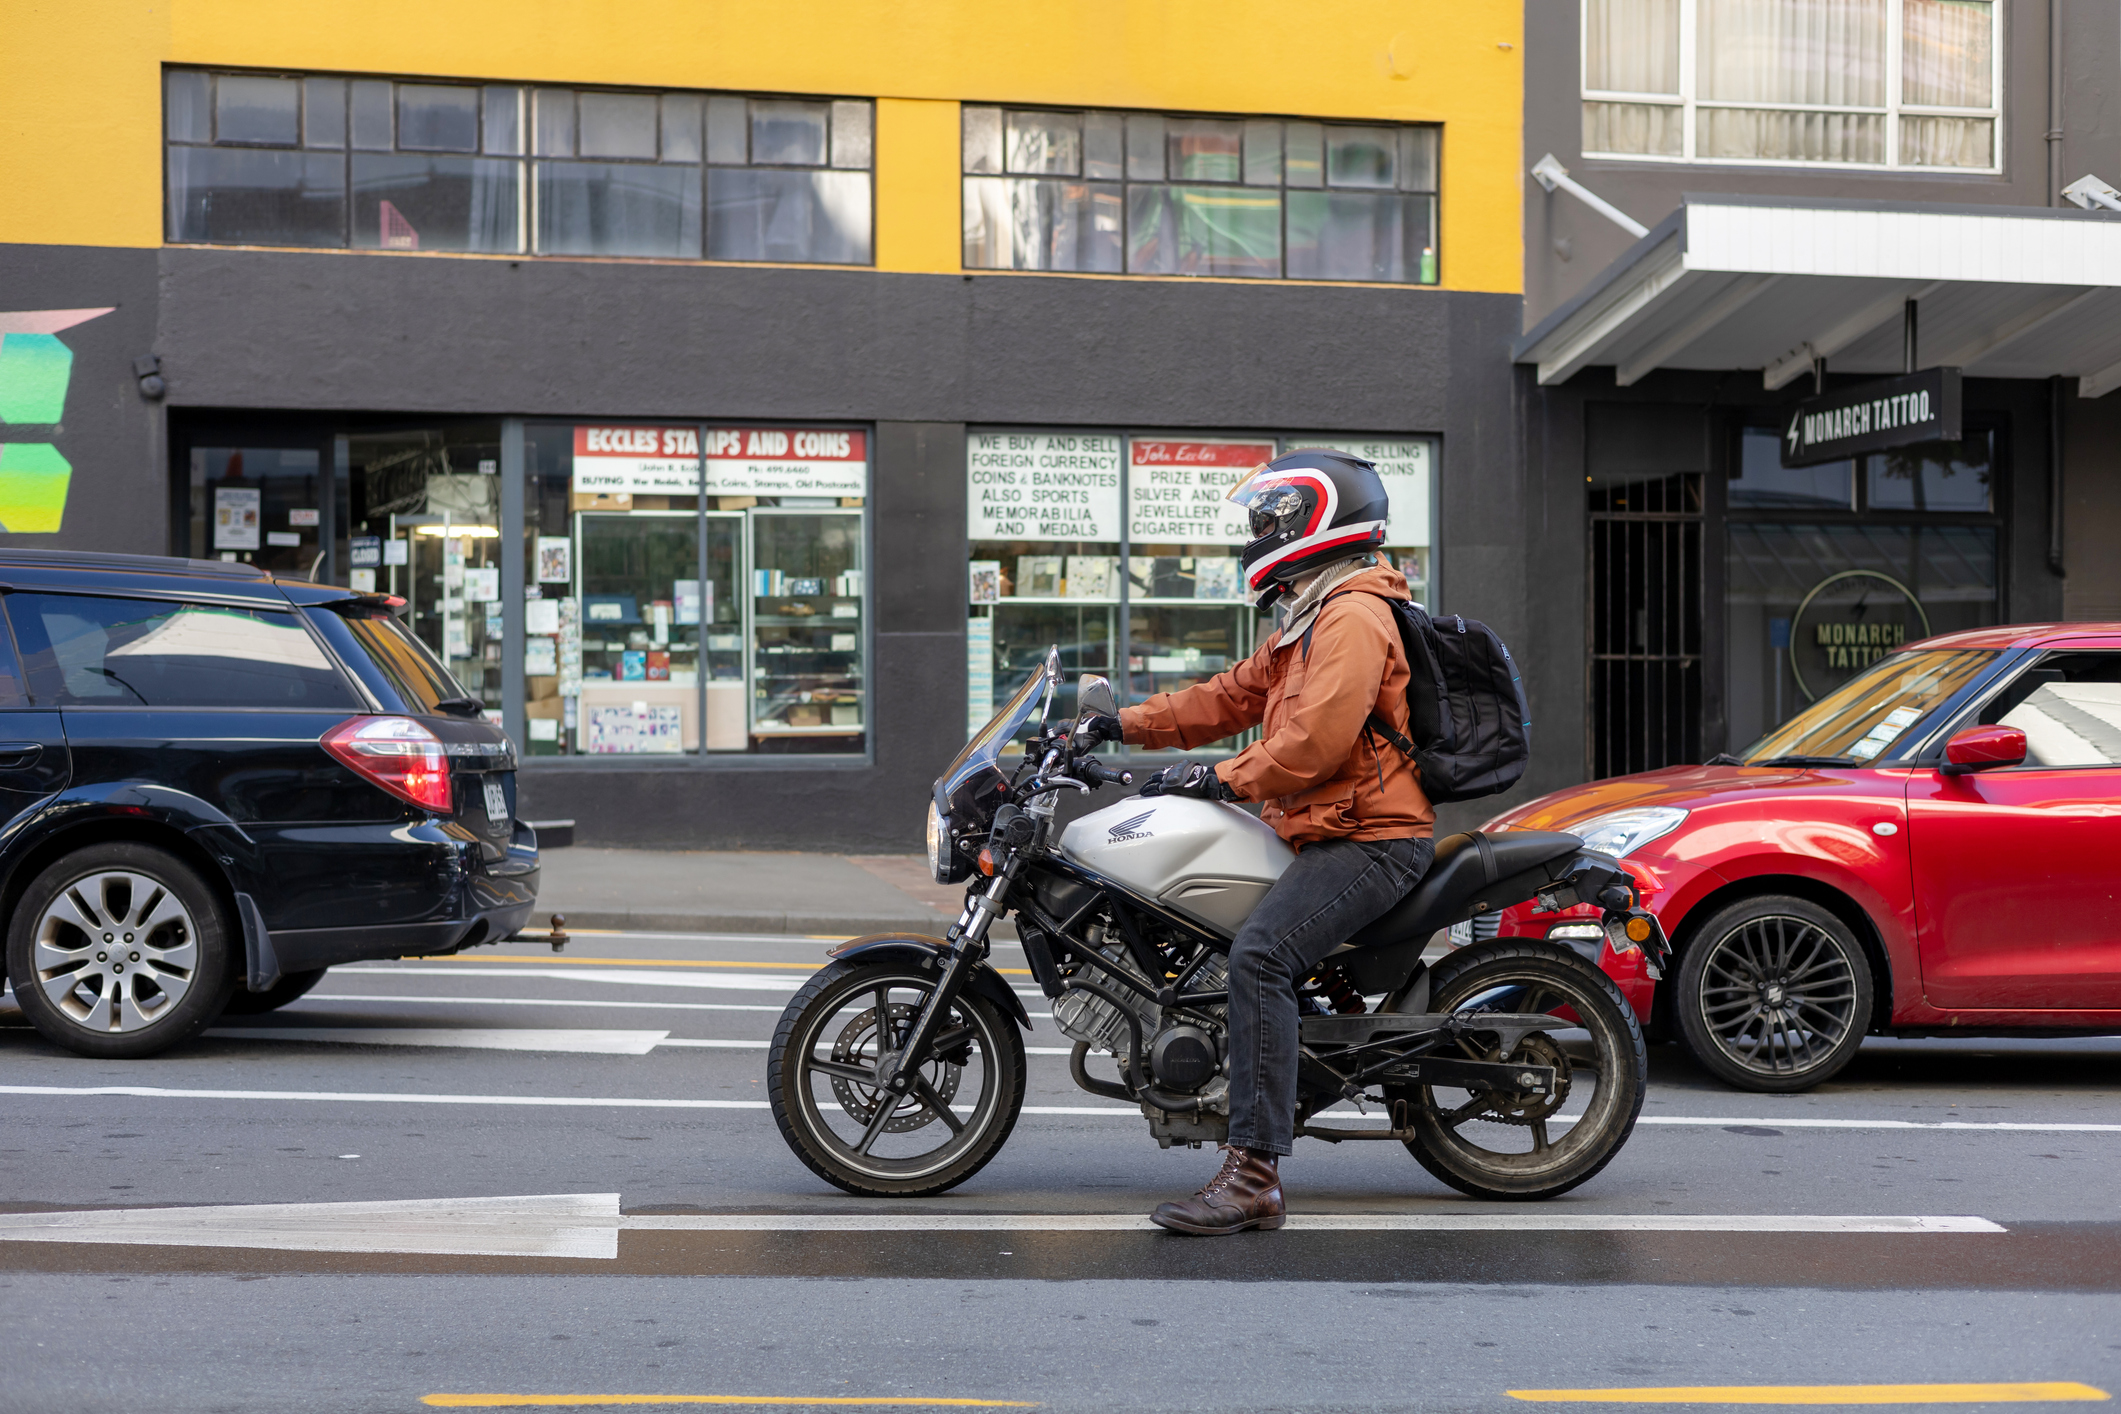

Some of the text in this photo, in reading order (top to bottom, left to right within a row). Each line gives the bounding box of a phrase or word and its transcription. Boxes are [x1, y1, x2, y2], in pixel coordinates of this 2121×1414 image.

[1804, 389, 1935, 445] MONARCH TATTOO.
[587, 428, 850, 458] ECCLES STAMPS AND COINS
[979, 436, 1116, 452] WE BUY AND SELL
[1136, 443, 1216, 464] John Eccles
[1364, 445, 1420, 458] SELLING
[972, 453, 1117, 470] FOREIGN CURRENCY
[582, 476, 624, 486] BUYING
[721, 478, 751, 489] Coins,
[754, 479, 792, 490] Stamps,
[796, 479, 813, 488] Old
[816, 480, 861, 489] Postcards
[972, 471, 1015, 484] COINS
[1033, 472, 1117, 487] BANKNOTES
[1151, 471, 1192, 484] PRIZE
[982, 489, 1089, 503] ALSO SPORTS
[1134, 488, 1220, 501] SILVER AND
[983, 506, 1092, 521] MEMORABILIA
[1135, 505, 1220, 519] JEWELLERY
[995, 522, 1098, 537] AND MEDALS
[1132, 522, 1252, 537] CIGARETTE CAR
[1817, 623, 1905, 645] MONARCH
[1108, 831, 1155, 844] HONDA
